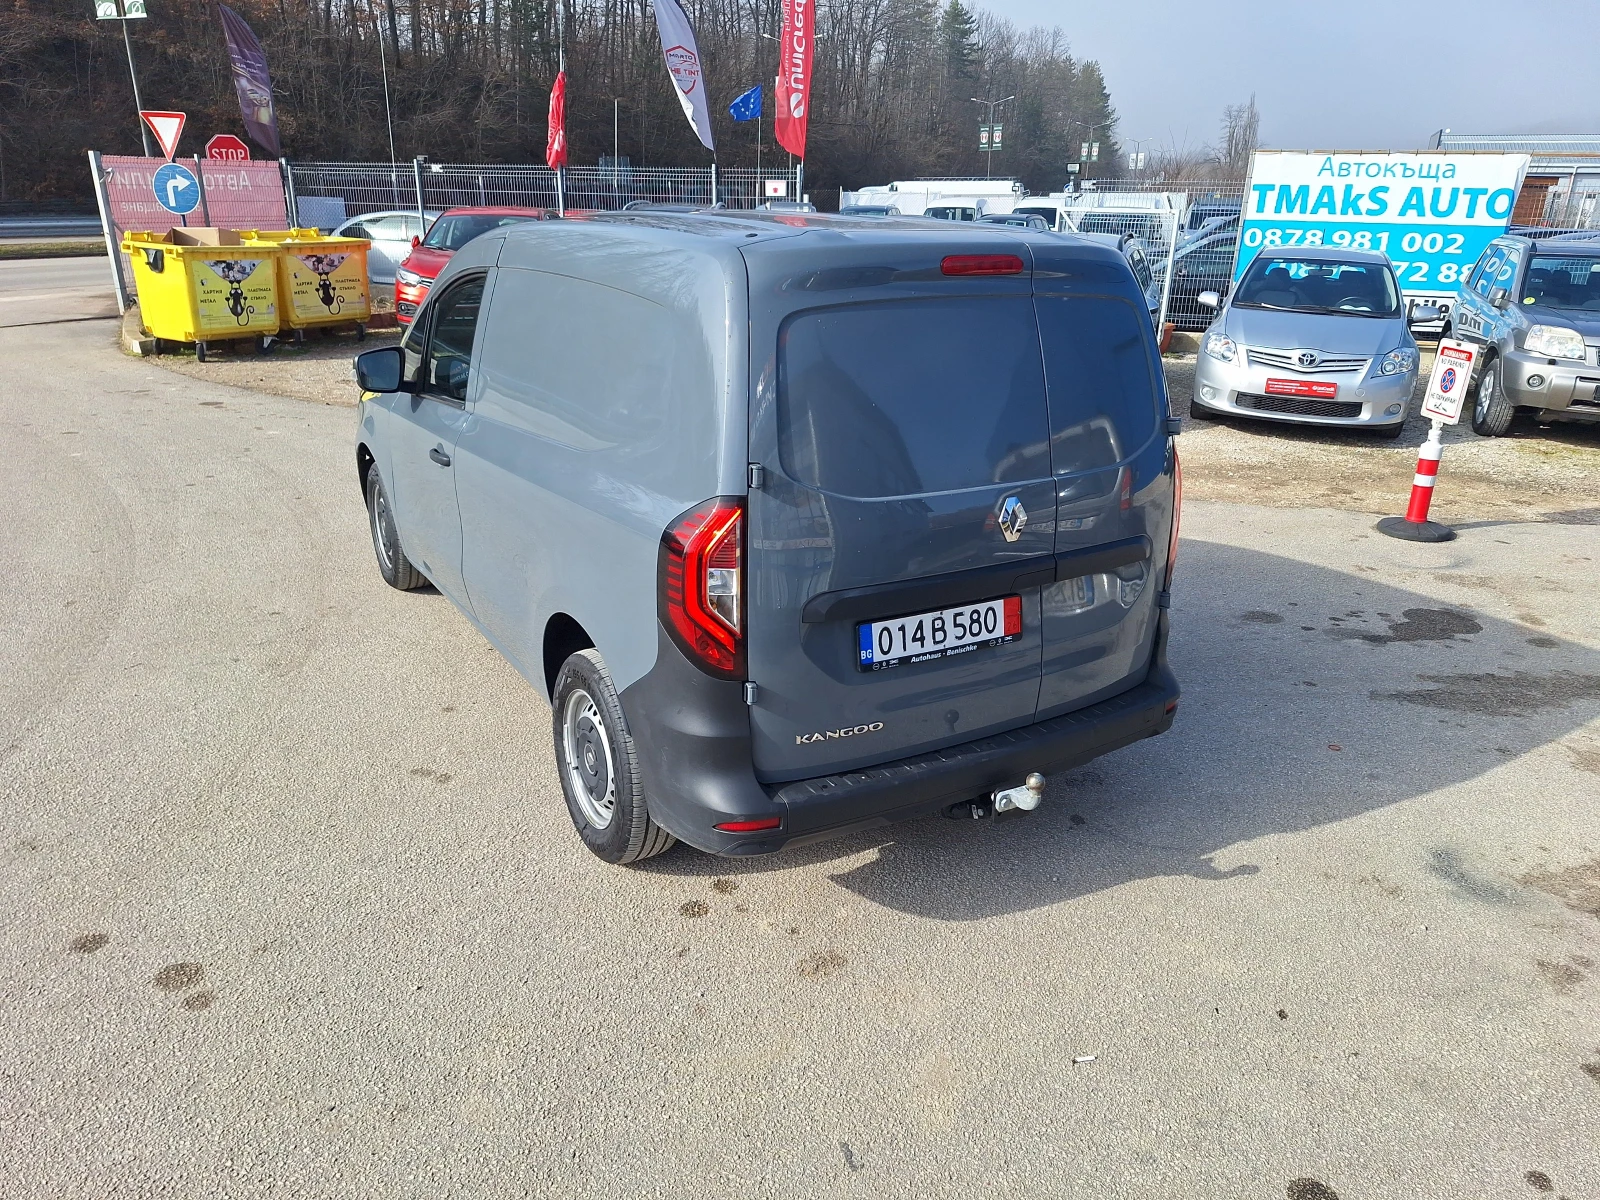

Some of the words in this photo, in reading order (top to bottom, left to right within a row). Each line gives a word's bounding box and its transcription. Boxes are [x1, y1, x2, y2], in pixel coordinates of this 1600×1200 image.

[211, 148, 245, 160] STOP
[1317, 156, 1456, 183] Автокъща
[1252, 184, 1390, 217] TMAkS
[1398, 188, 1515, 219] AUTO
[1243, 227, 1323, 248] 0878
[1331, 230, 1391, 252] 981
[1401, 232, 1465, 254] 002
[860, 649, 873, 660] BG
[910, 649, 942, 664] Autohaus
[946, 644, 978, 658] Benischke
[795, 721, 884, 745] KANGOO
